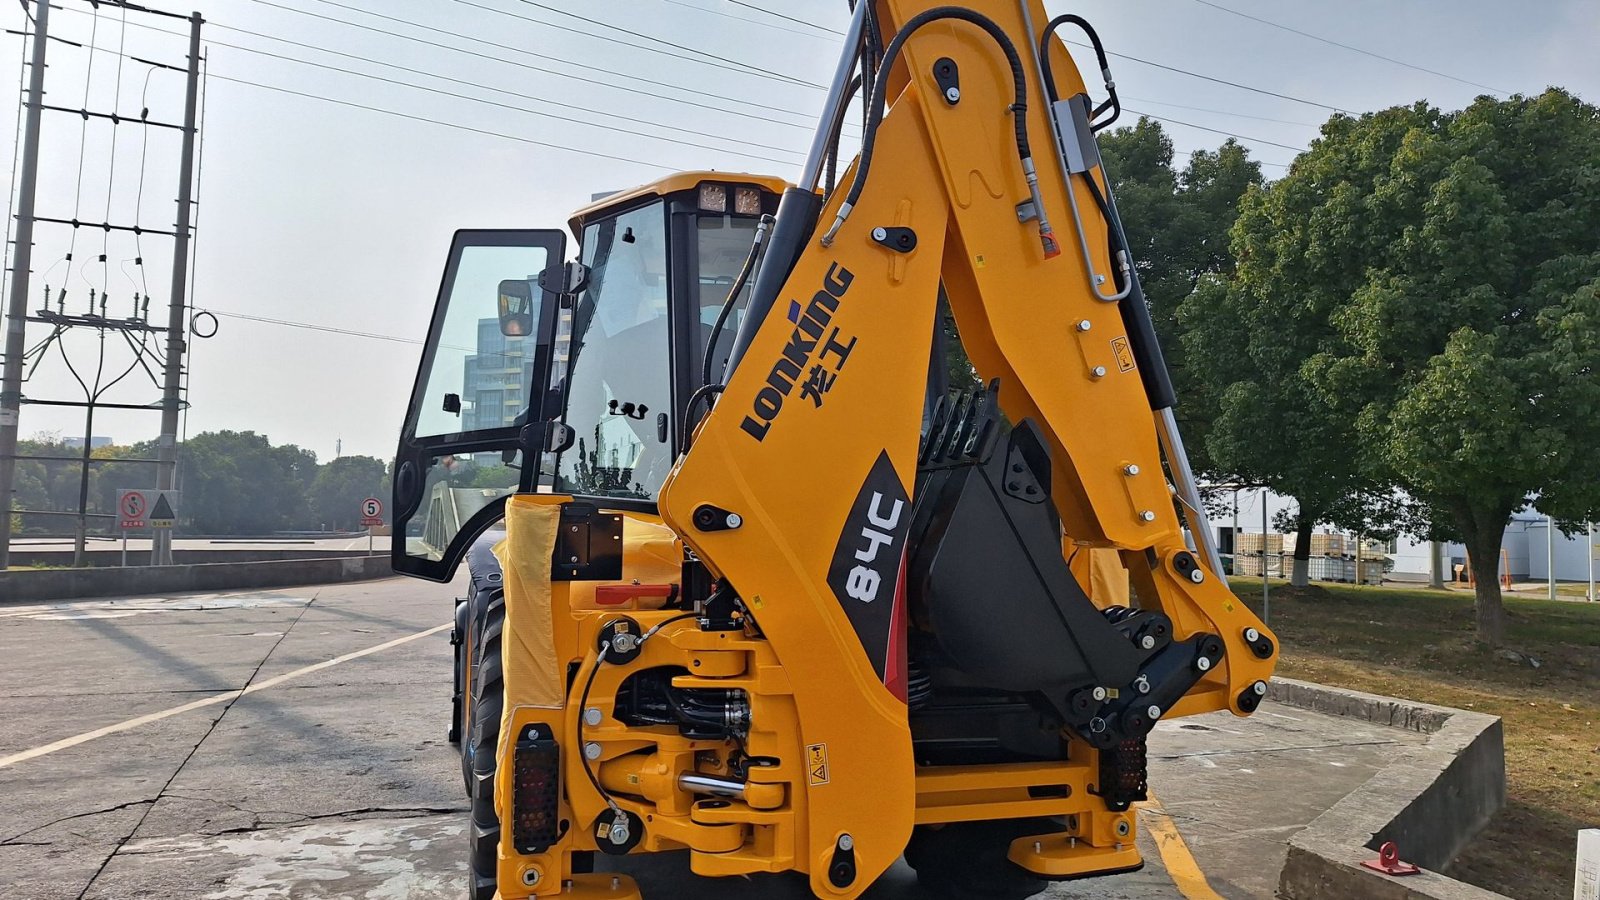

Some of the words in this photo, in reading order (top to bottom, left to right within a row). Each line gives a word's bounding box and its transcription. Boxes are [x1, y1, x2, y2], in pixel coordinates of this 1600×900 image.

[740, 261, 855, 442] LONKING
[800, 326, 858, 409] 龙工
[368, 502, 375, 515] 5
[845, 490, 905, 604] 84C
